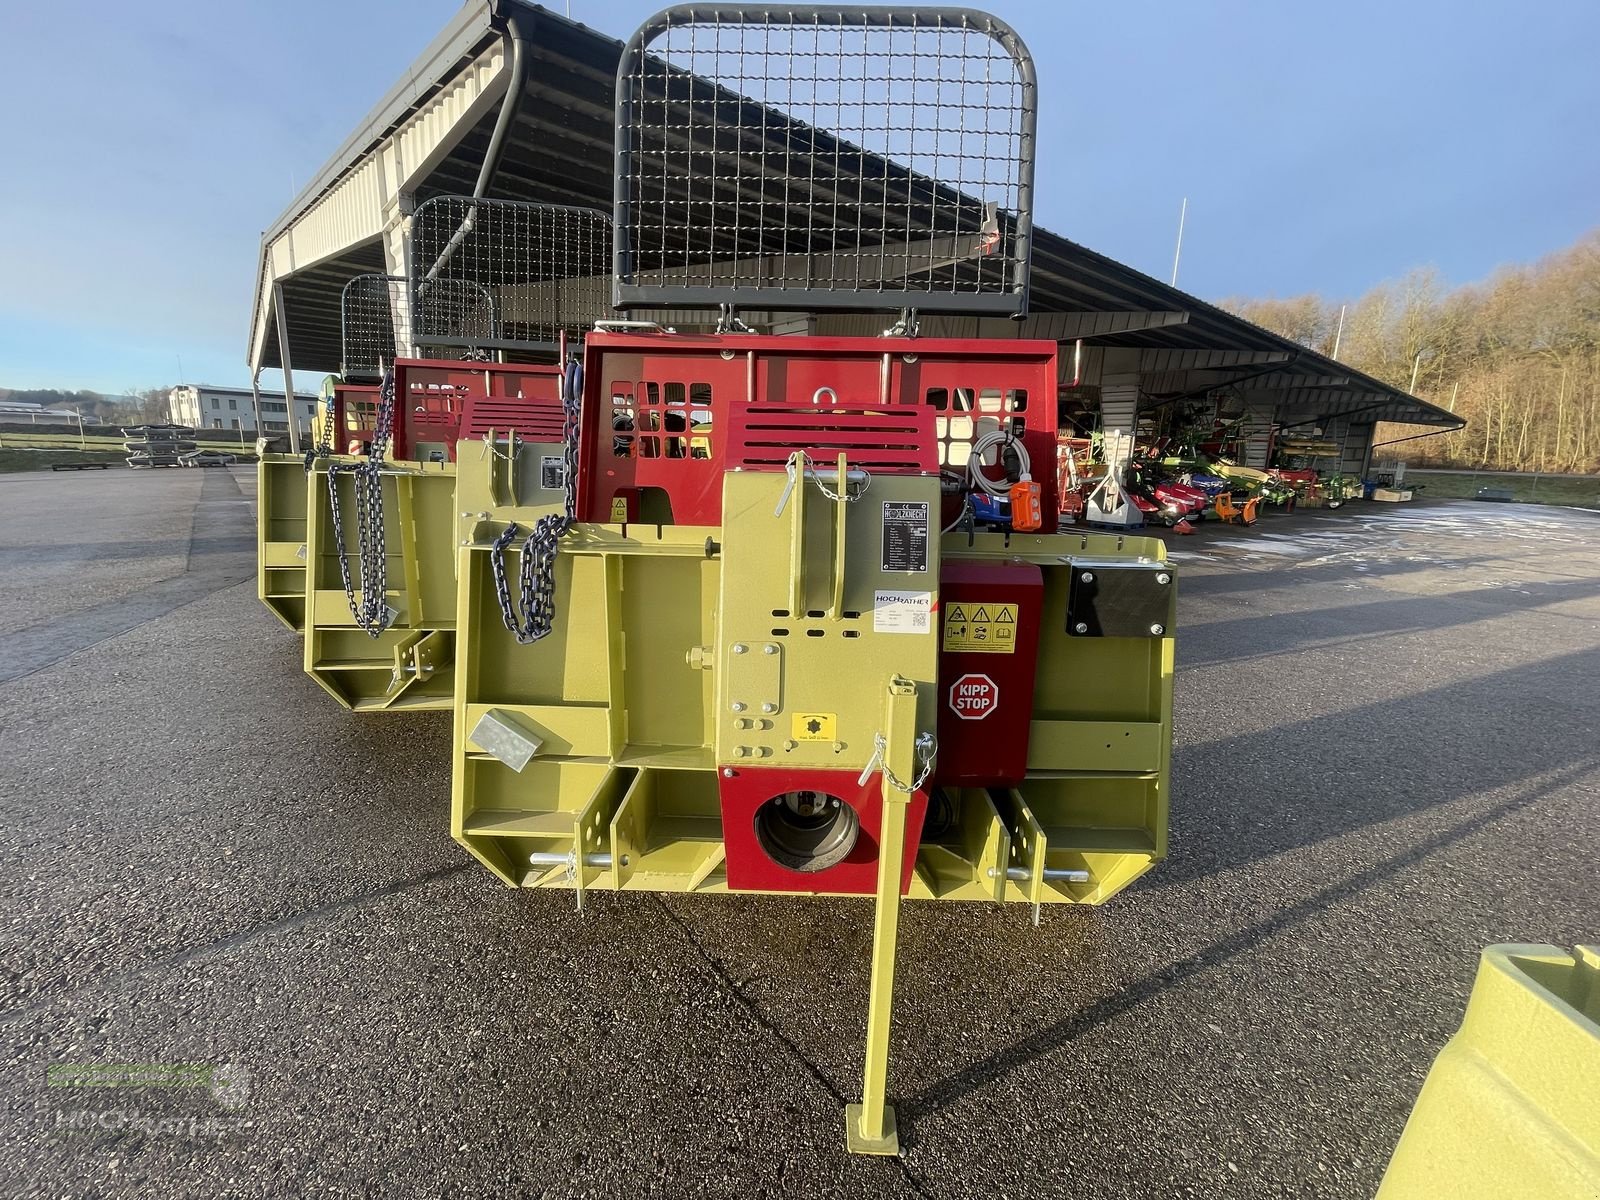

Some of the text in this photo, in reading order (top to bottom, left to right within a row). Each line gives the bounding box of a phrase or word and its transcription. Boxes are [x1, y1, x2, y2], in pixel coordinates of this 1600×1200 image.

[876, 595, 929, 605] HOCHRATHER
[959, 684, 990, 696] KIPP
[956, 698, 990, 710] STOP
